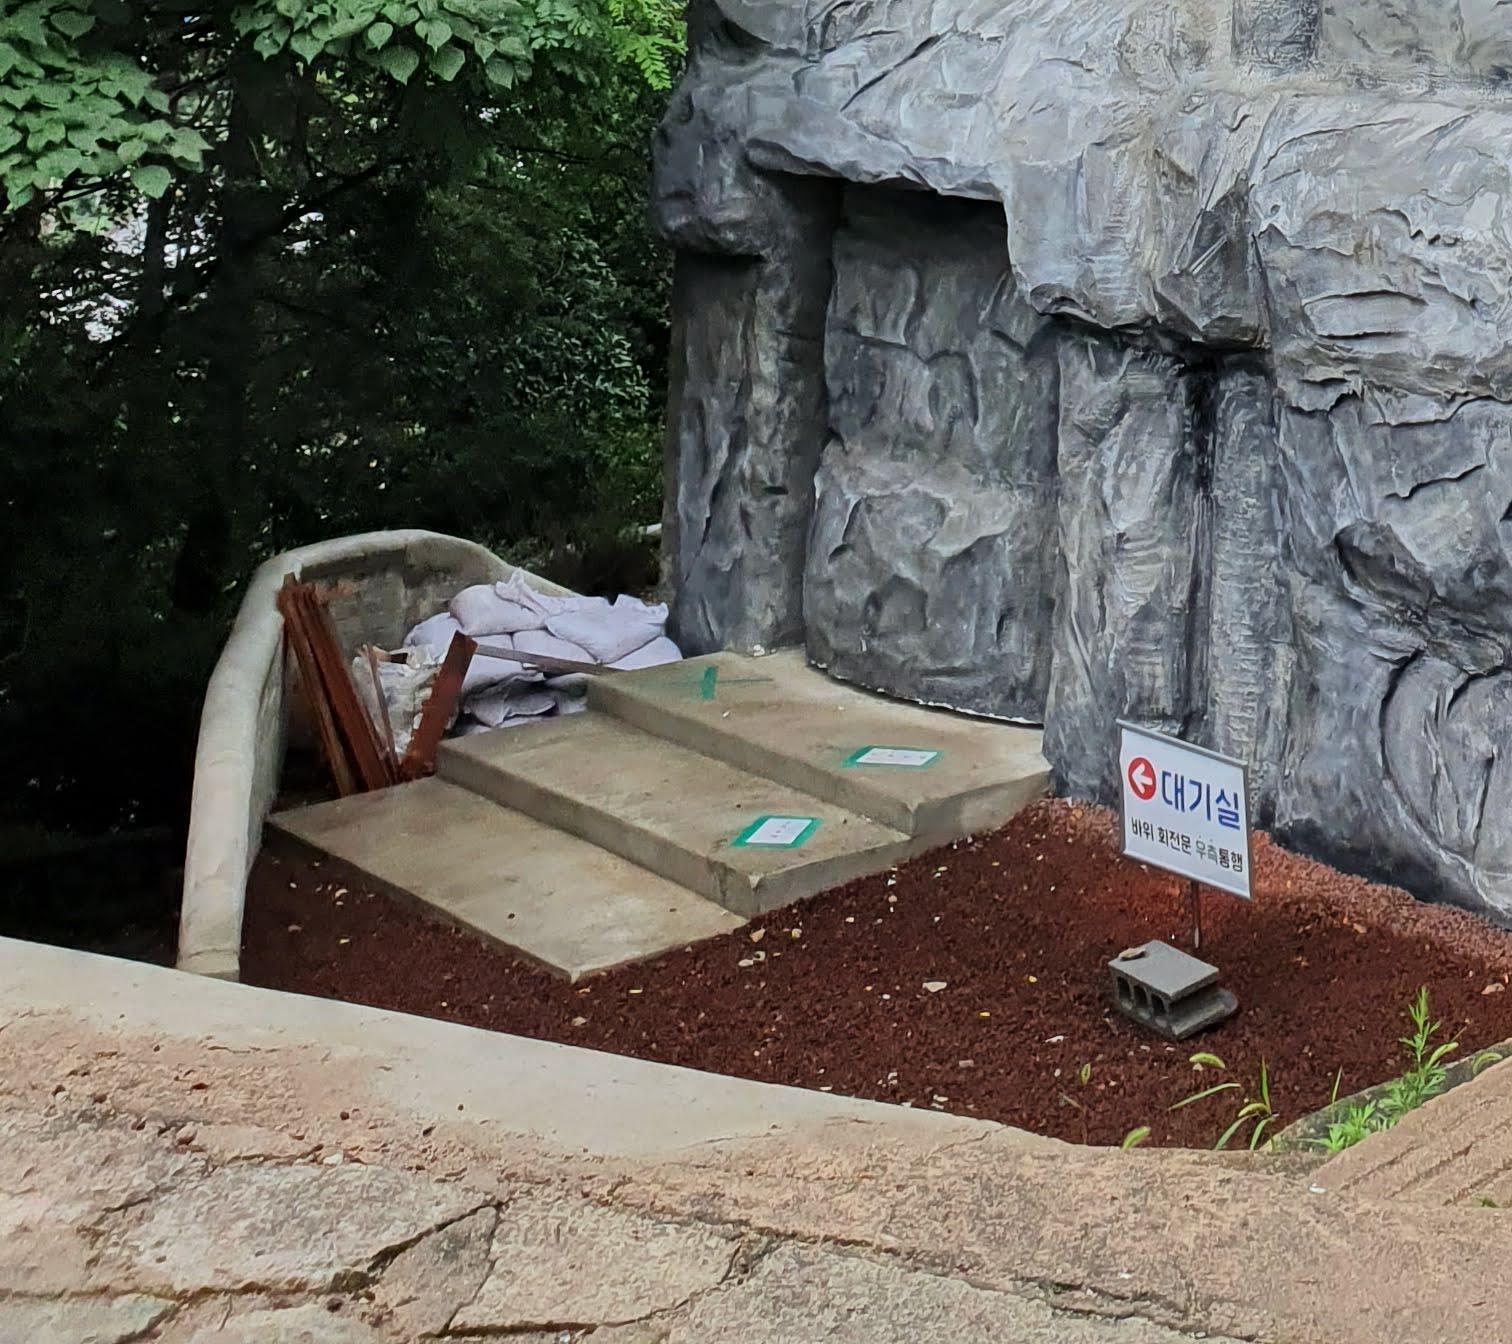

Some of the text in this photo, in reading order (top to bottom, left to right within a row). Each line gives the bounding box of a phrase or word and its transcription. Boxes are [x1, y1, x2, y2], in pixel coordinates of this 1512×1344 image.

[1161, 770, 1241, 831] 대기실
[1130, 816, 1154, 842] 바위
[1157, 826, 1192, 857] 회전문
